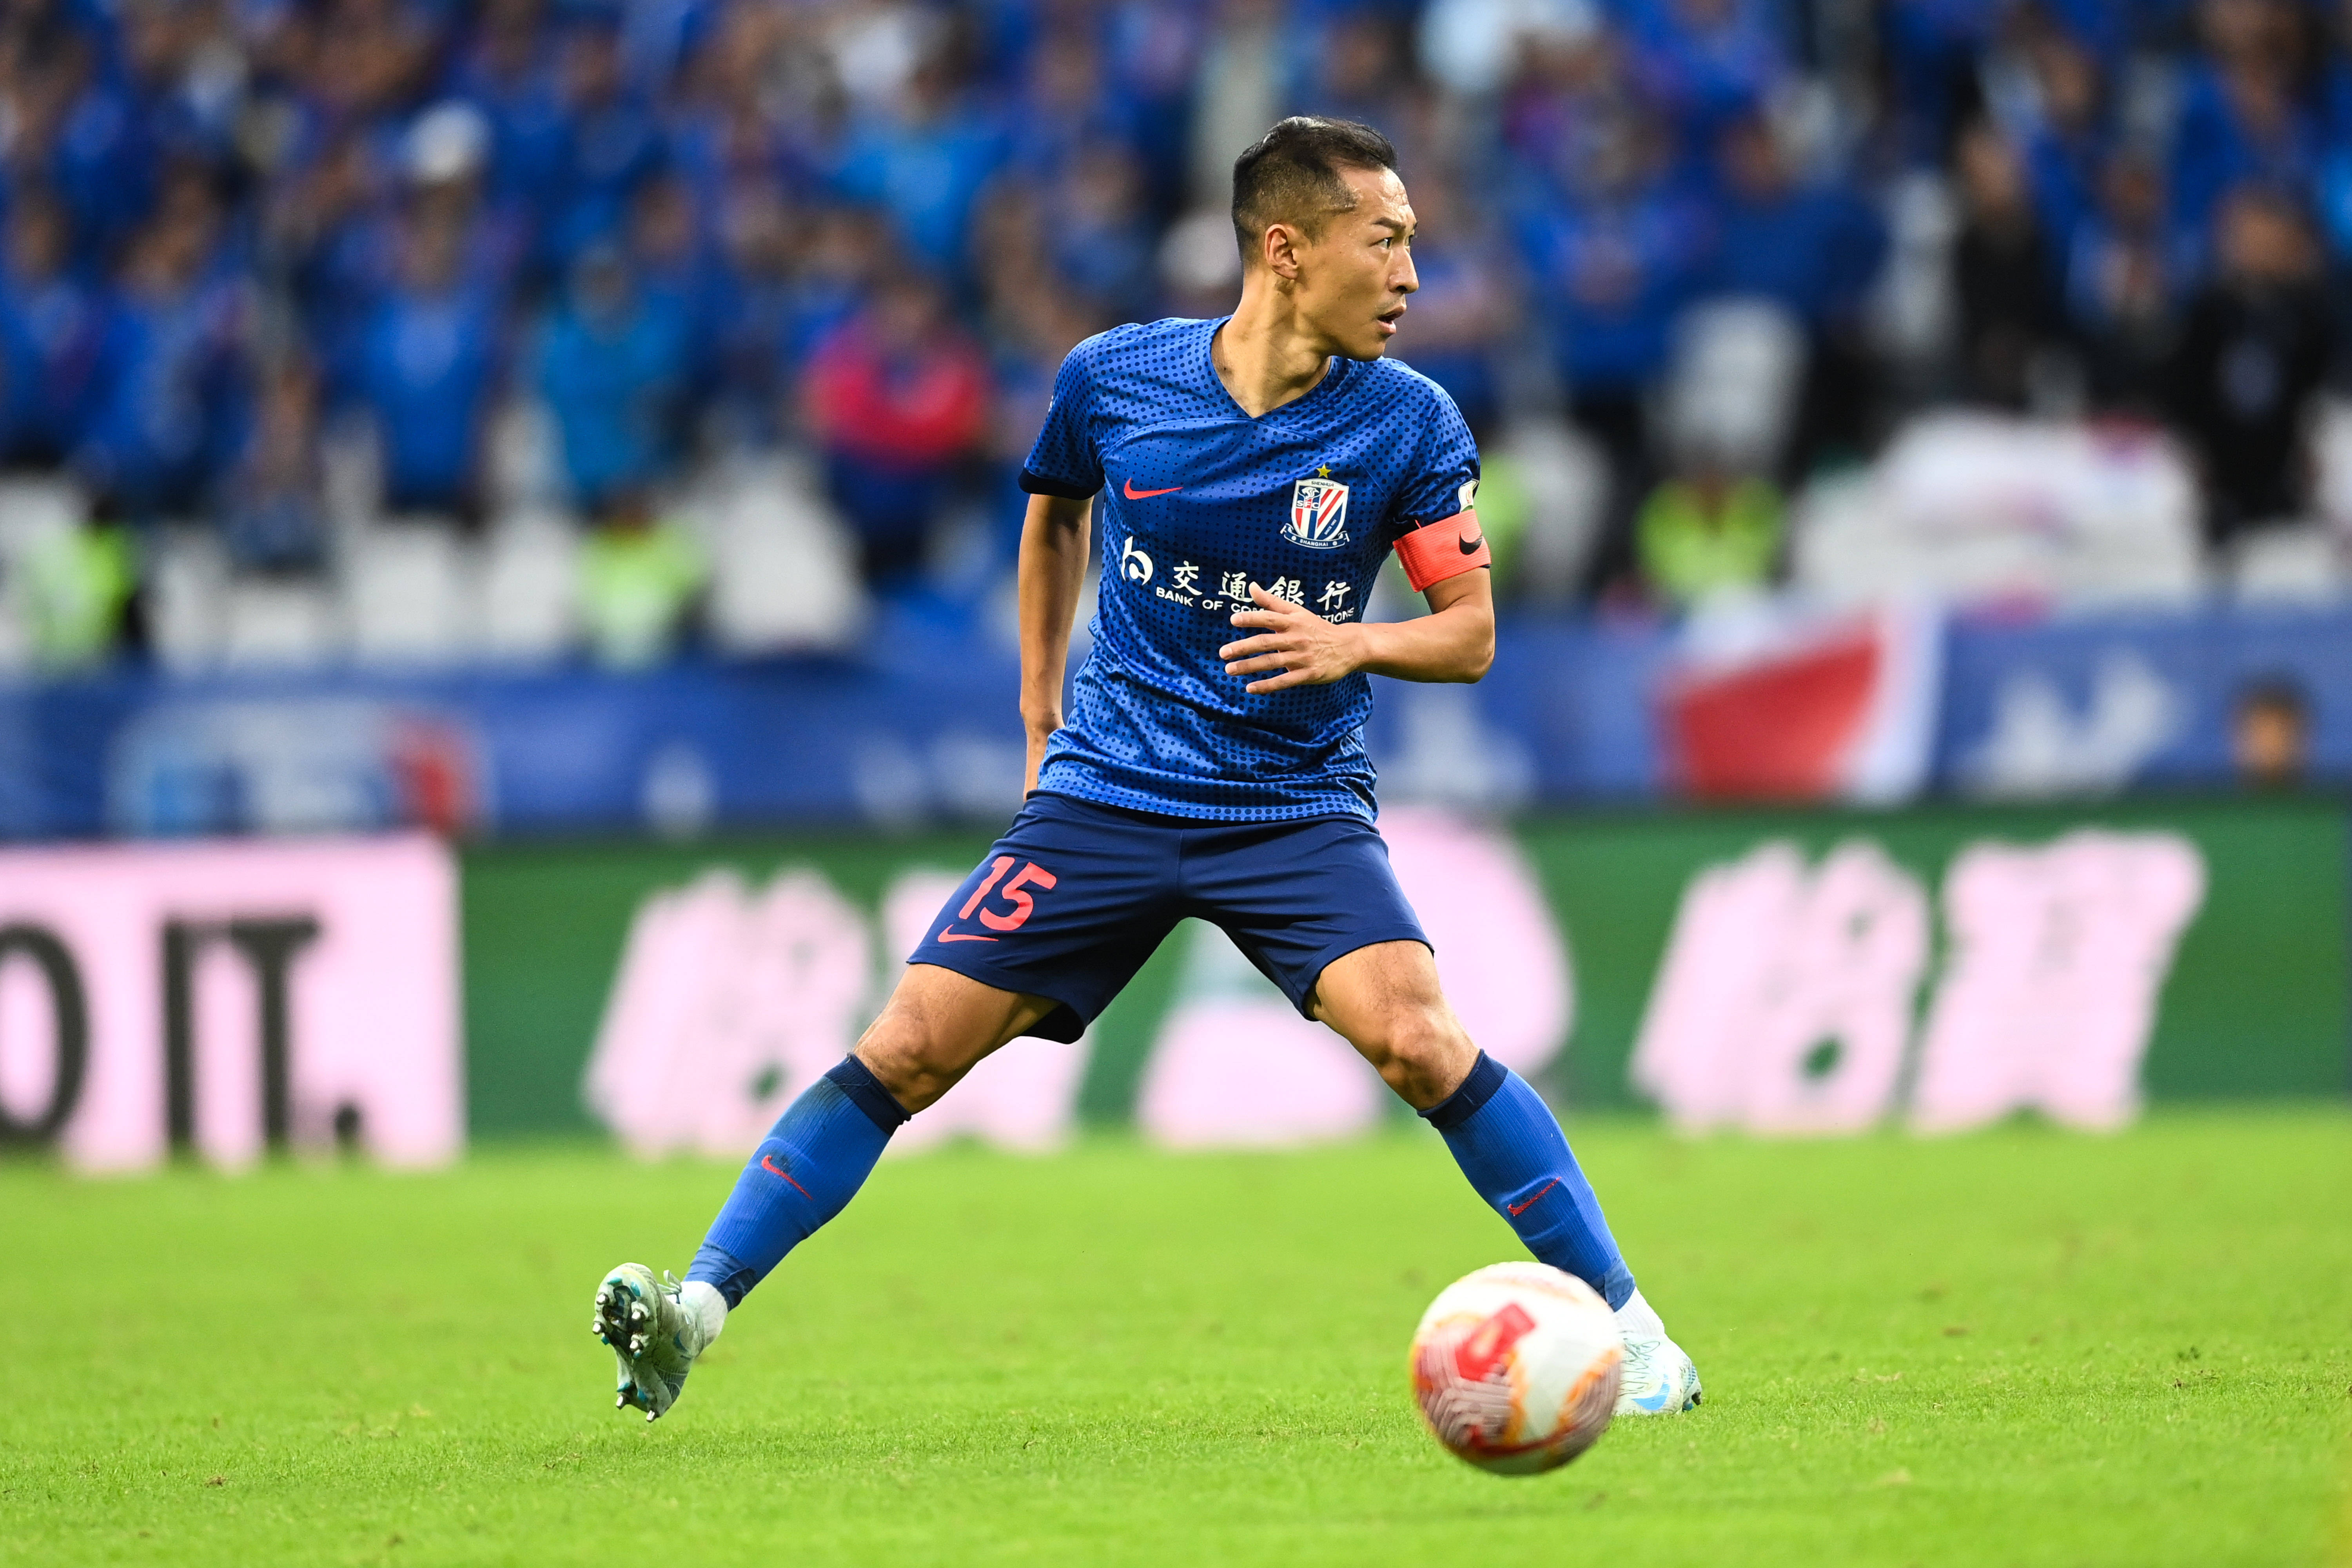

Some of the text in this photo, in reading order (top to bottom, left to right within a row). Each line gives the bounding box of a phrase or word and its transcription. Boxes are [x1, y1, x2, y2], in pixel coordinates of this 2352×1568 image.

[1296, 500, 1319, 509] SFC
[1156, 586, 1194, 607] BANK
[1202, 599, 1223, 610] OF
[958, 856, 1057, 931] 15
